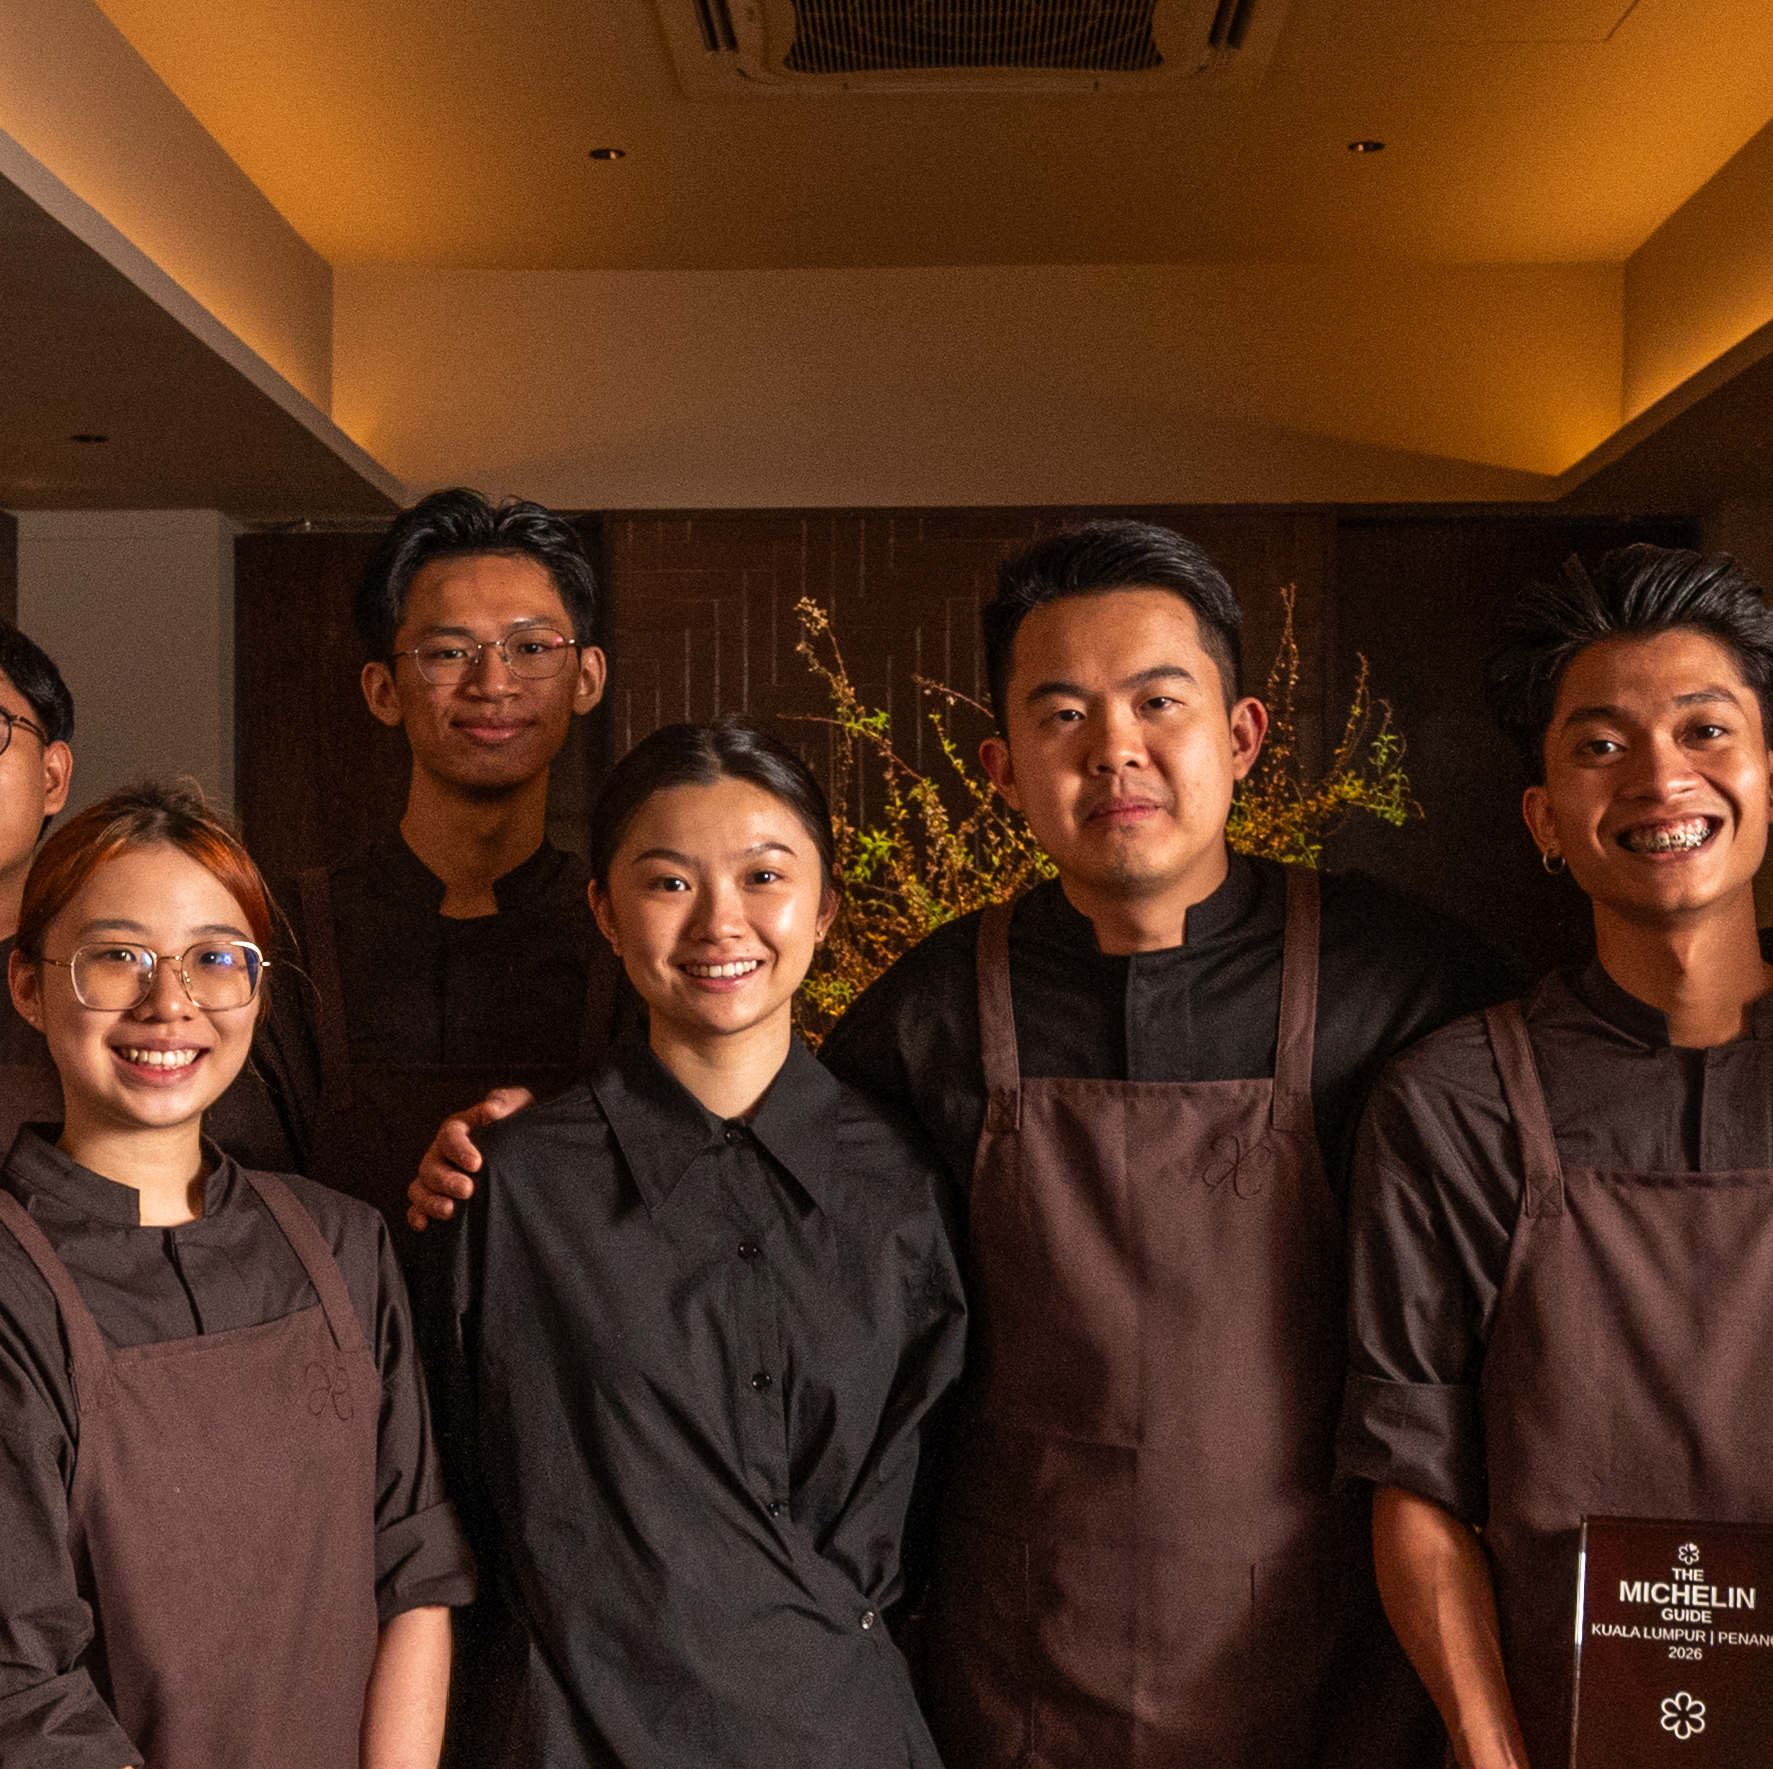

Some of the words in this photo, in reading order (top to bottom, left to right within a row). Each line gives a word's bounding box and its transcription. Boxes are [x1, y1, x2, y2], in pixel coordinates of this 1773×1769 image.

[1671, 1567, 1704, 1582] THE
[1619, 1580, 1756, 1609] MICHELIN
[1661, 1607, 1712, 1624] GUIDE
[1591, 1623, 1641, 1639] KUALA
[1643, 1626, 1706, 1642] LUMPUR
[1668, 1645, 1703, 1660] 2026
